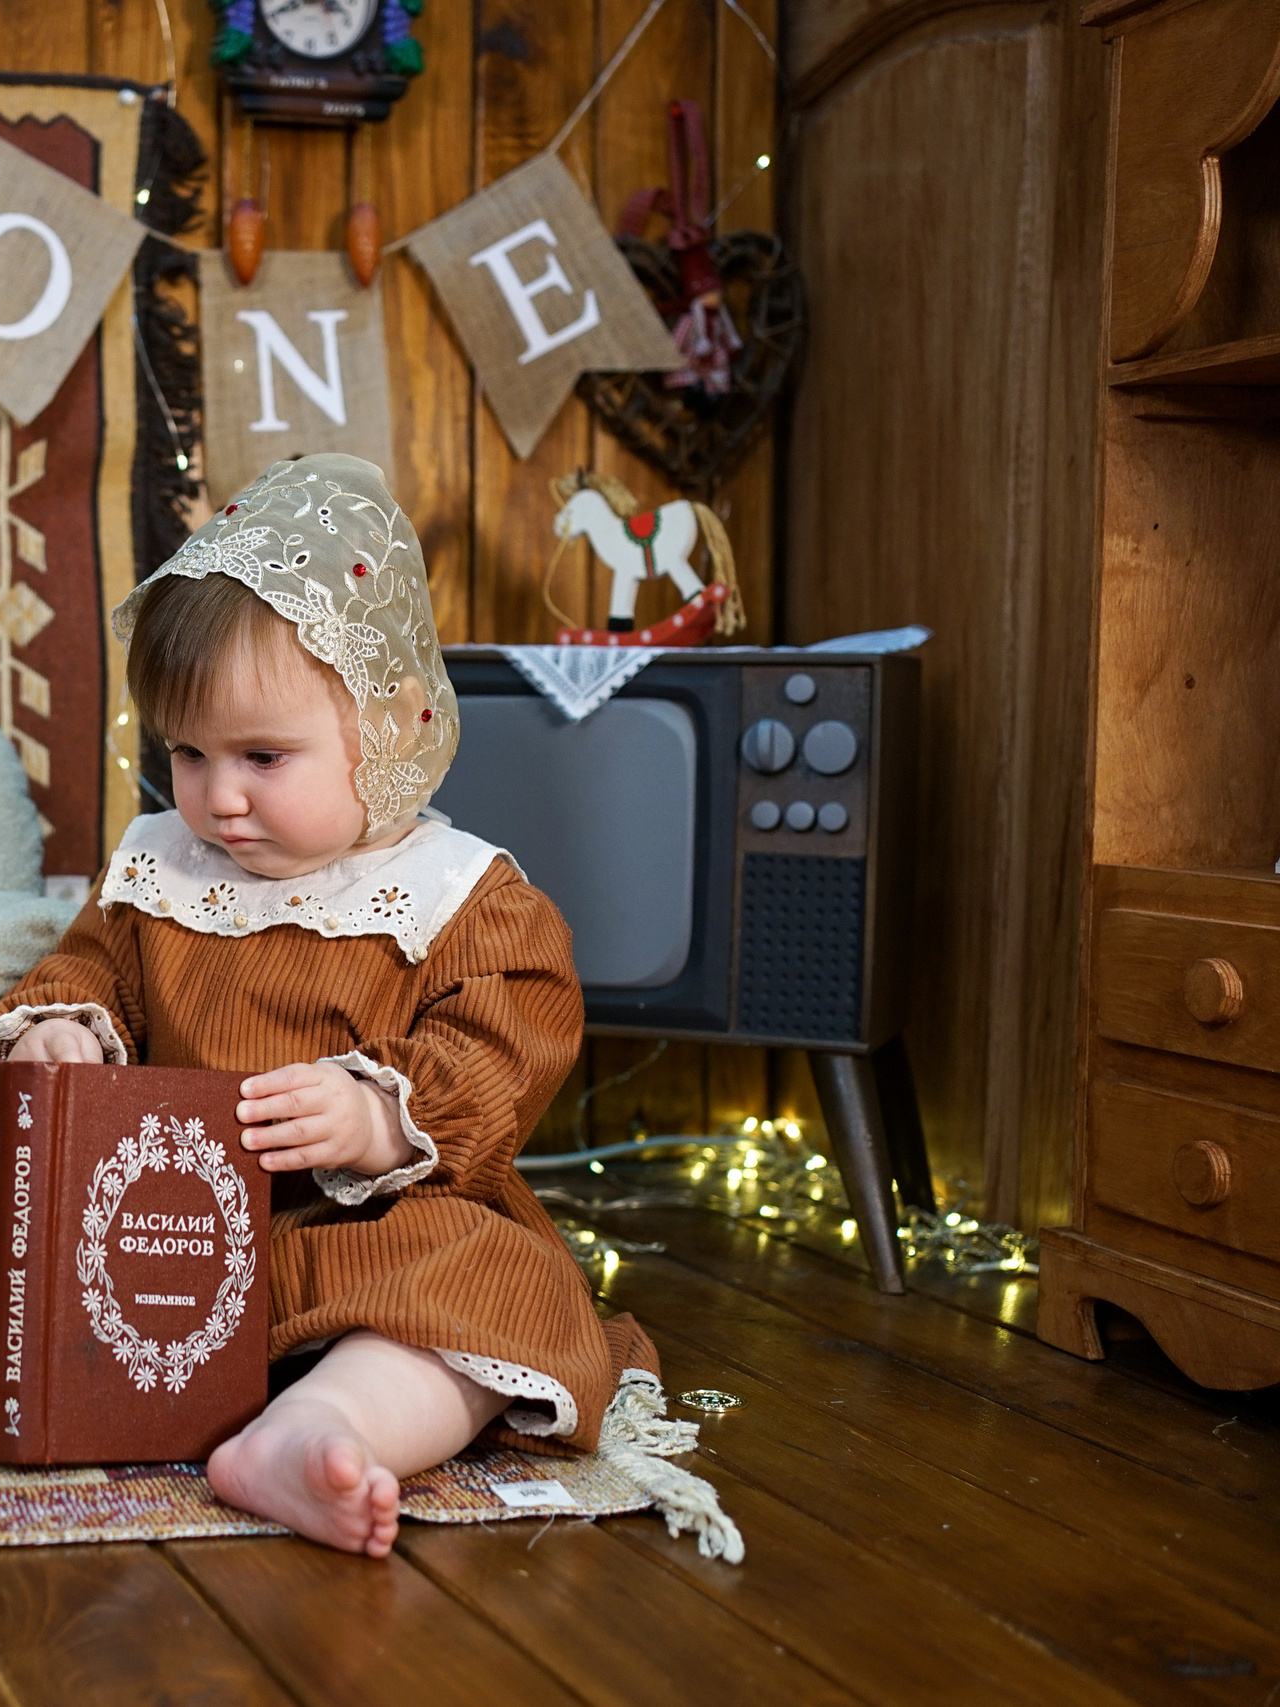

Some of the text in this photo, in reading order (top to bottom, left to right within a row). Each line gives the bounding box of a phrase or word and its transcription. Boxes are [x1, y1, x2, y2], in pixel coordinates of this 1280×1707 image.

[121, 1212, 216, 1234] ВАСИЛИЙ
[120, 1235, 215, 1257] ФЕДОРОВ
[6, 1145, 32, 1383] ВАСИЛИЙ ФЕДОРОВ
[134, 1293, 196, 1307] ИЗБРАННОЕ
